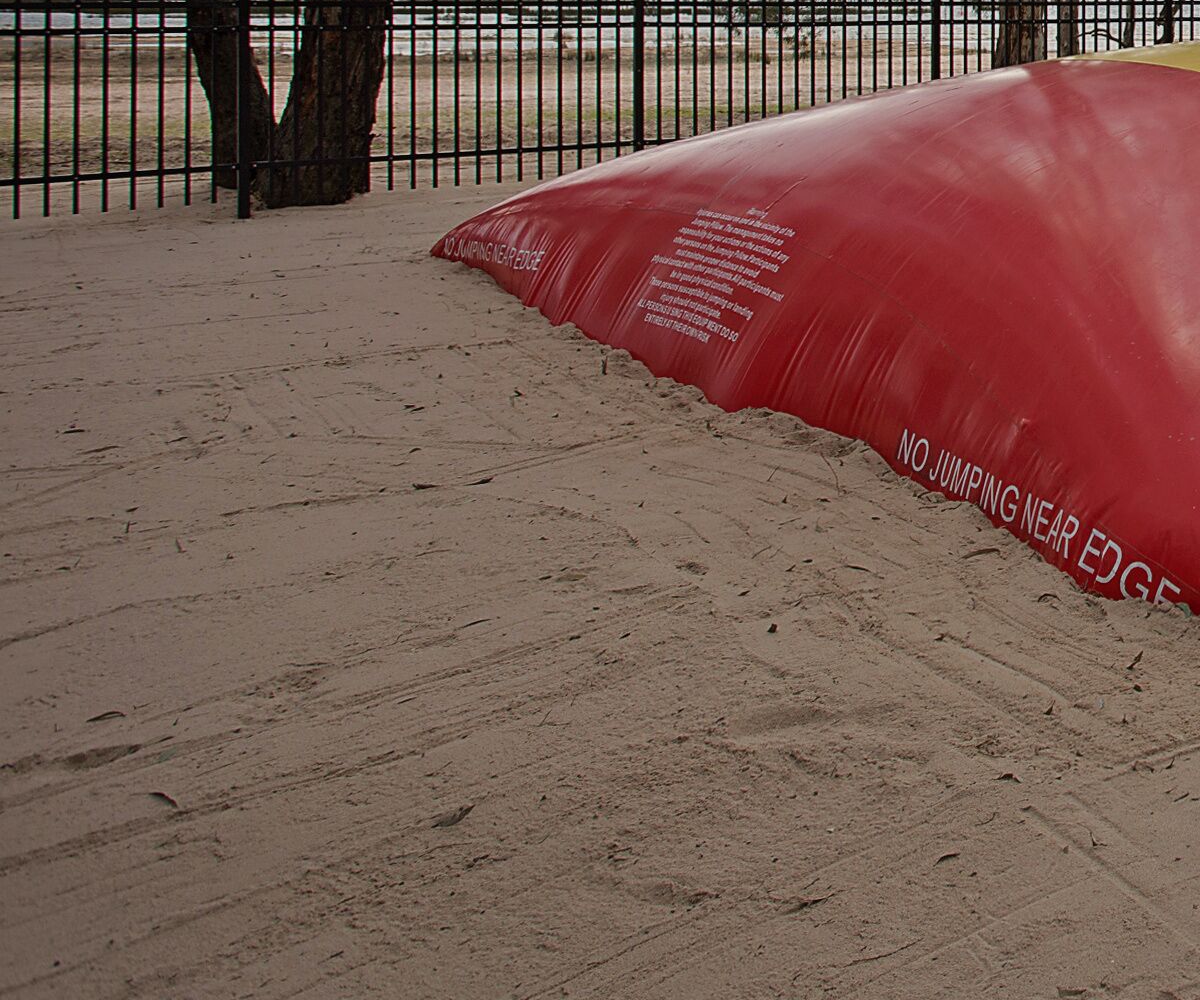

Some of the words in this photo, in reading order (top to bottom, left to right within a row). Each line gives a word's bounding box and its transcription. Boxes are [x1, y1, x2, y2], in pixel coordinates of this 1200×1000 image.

[492, 244, 516, 267] NEAR
[513, 249, 545, 270] EDGE
[898, 428, 929, 472] NO
[929, 449, 1020, 522] JUMPING
[1021, 493, 1079, 558] NEAR
